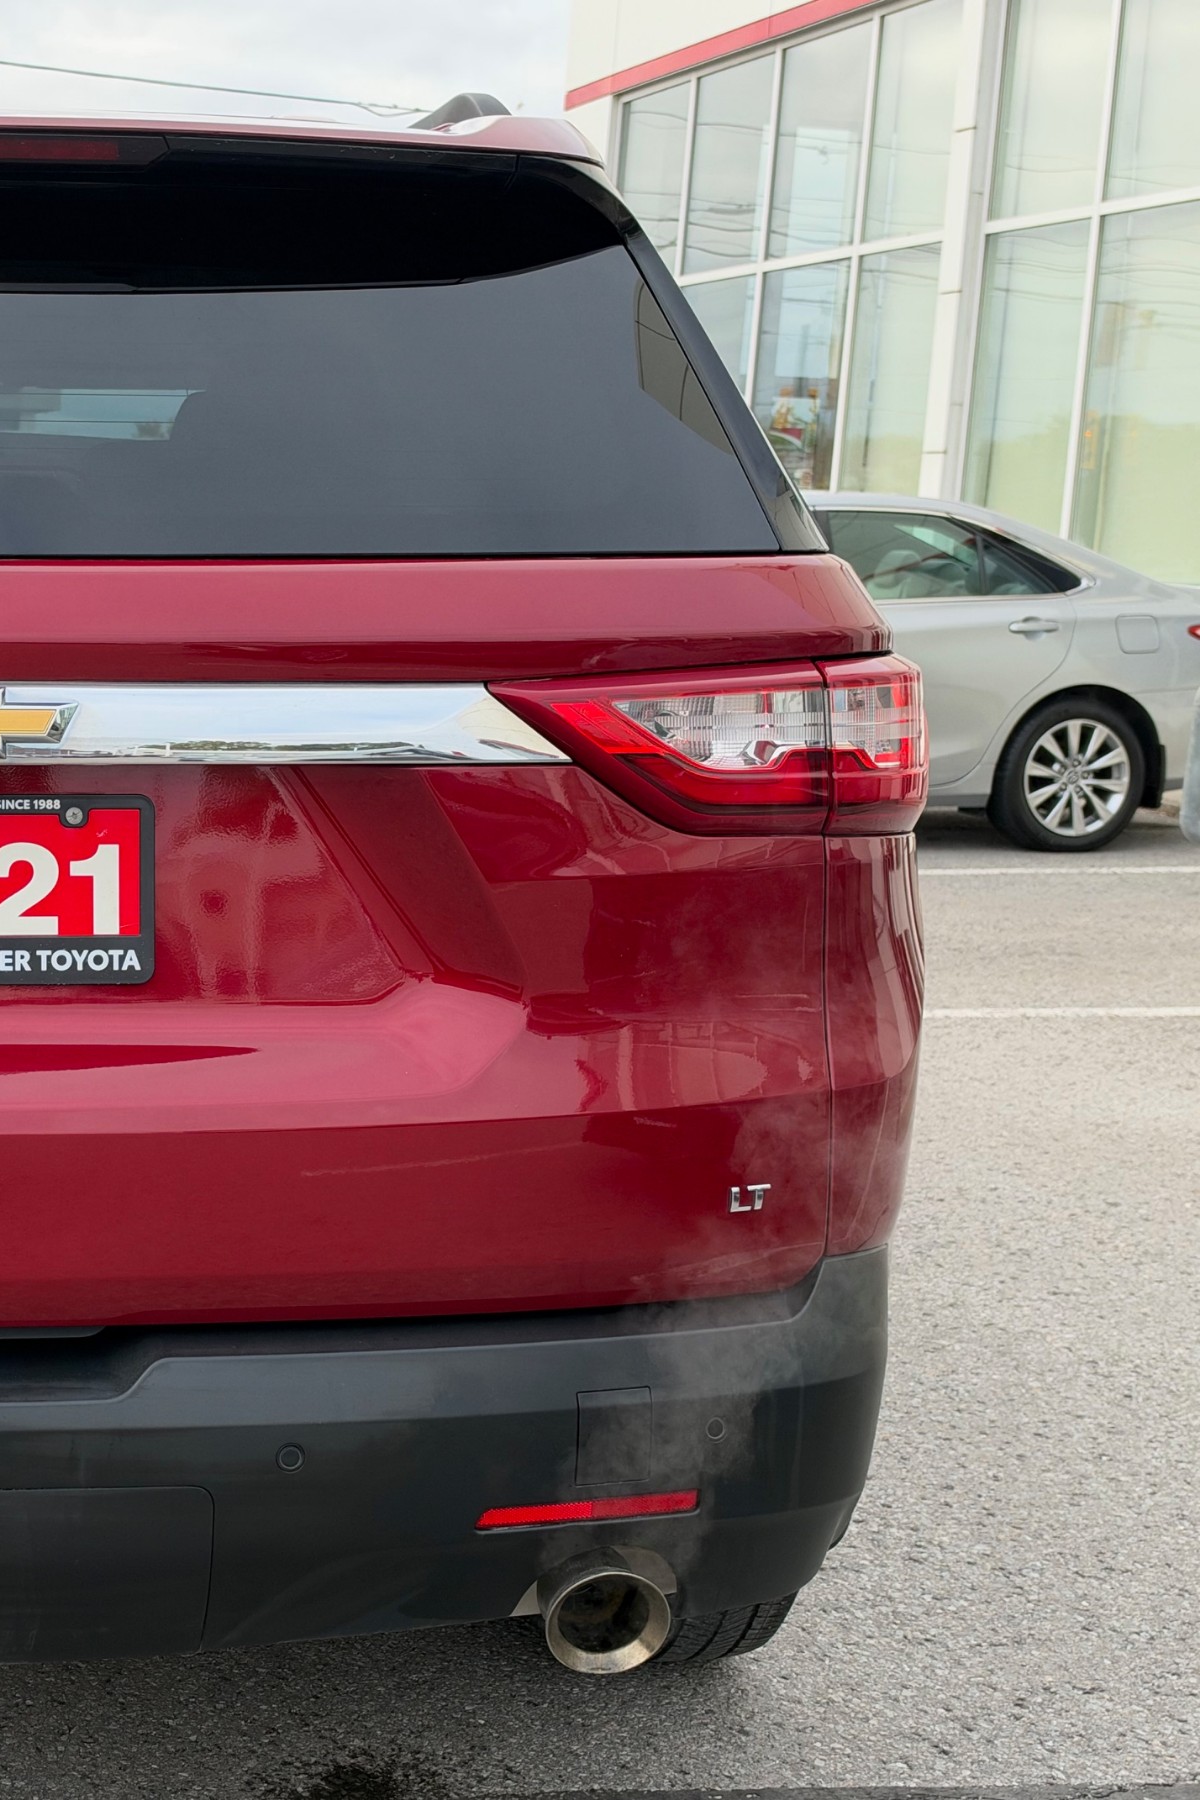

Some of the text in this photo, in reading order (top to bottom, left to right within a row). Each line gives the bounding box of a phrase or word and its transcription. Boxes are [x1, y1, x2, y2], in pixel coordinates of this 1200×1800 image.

[33, 799, 62, 811] 1988
[36, 949, 142, 972] TOYOTA
[729, 1183, 772, 1213] LT
